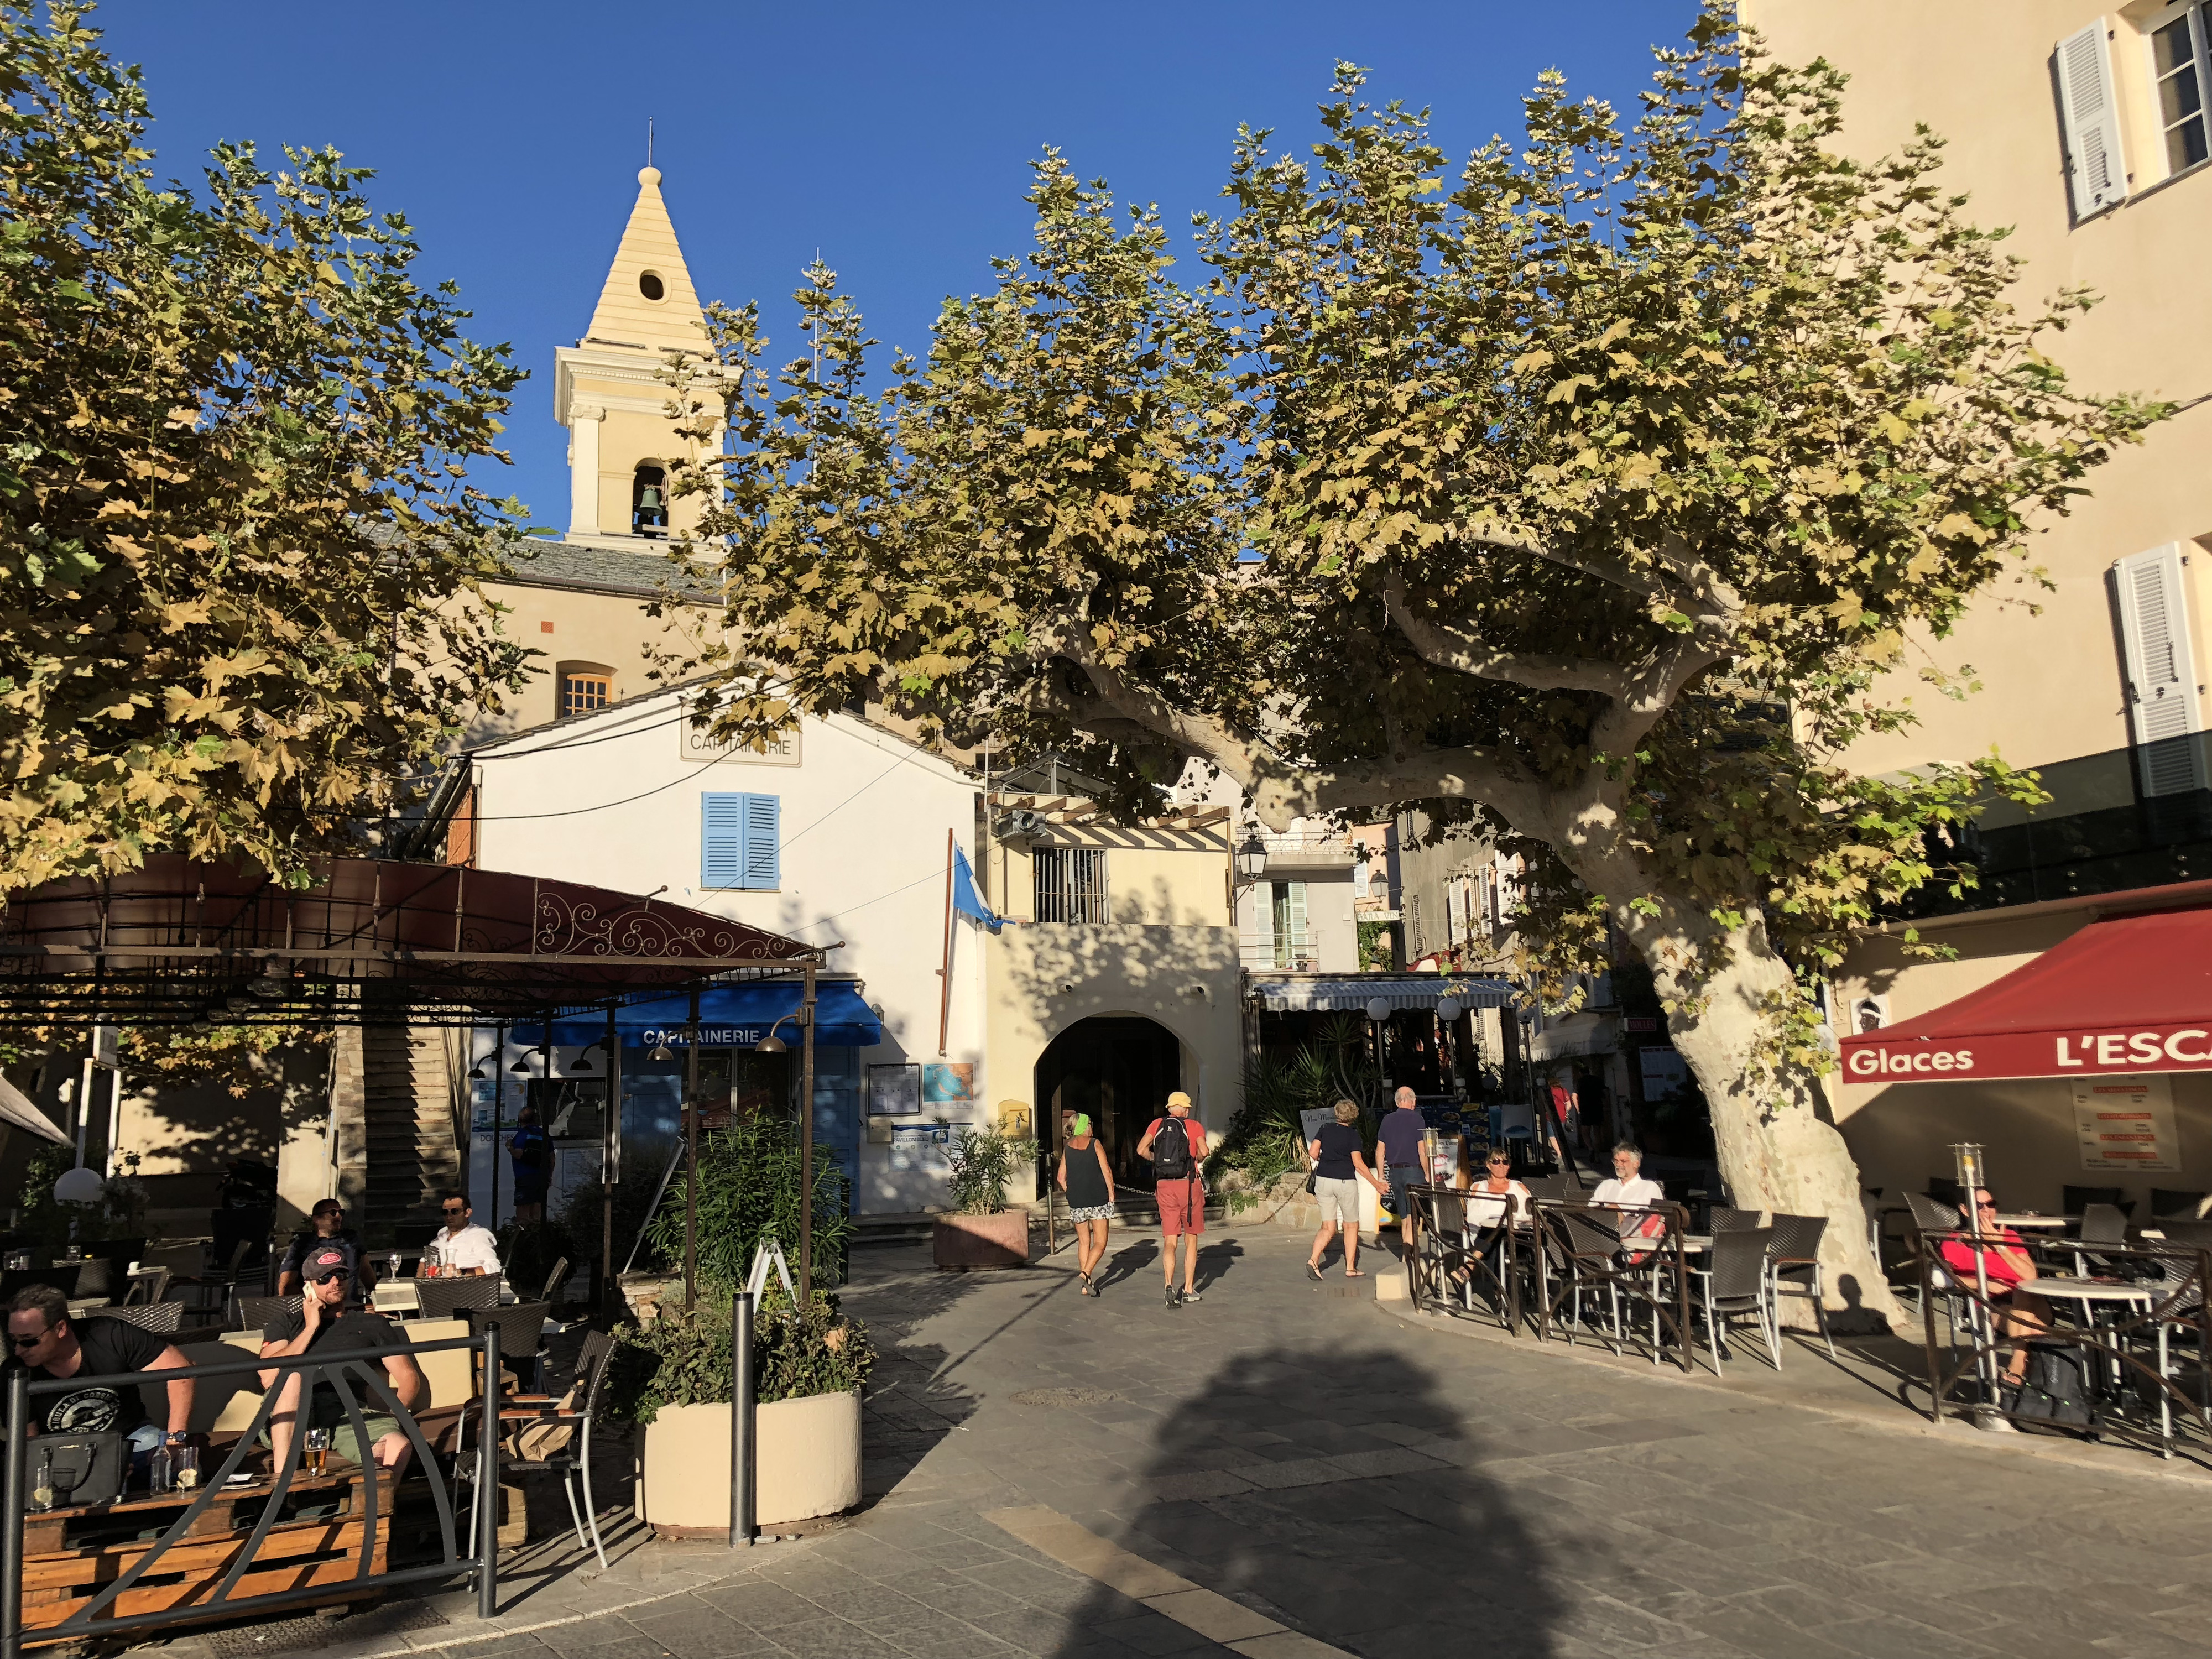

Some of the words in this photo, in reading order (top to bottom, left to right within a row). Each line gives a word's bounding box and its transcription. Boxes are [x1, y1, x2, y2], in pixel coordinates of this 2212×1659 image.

[691, 734, 791, 755] CAPITAIRIE
[643, 1030, 759, 1044] CAPIAINERIE
[2057, 1030, 2212, 1066] L'ESC
[1849, 1048, 1974, 1075] Glaces
